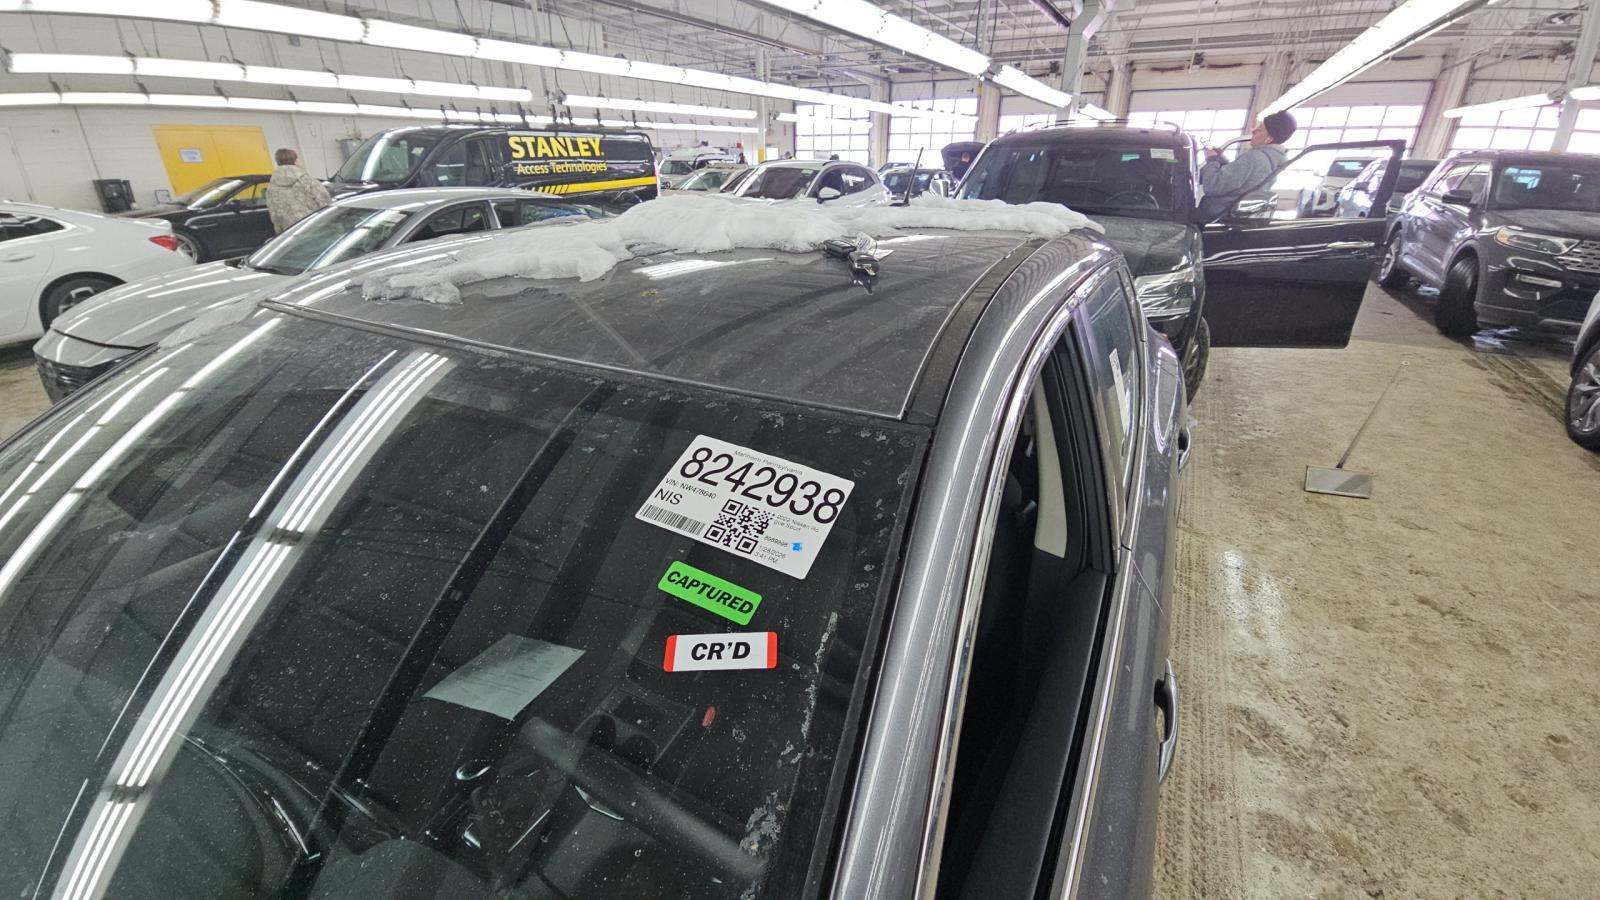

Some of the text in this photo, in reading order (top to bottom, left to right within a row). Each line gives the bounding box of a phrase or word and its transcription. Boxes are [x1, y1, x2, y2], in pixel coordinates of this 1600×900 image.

[517, 160, 608, 175] Access Technologies
[680, 447, 846, 524] 8242938
[654, 488, 683, 505] NIS
[667, 569, 754, 614] CAPTURED
[691, 641, 751, 661] CR'D
